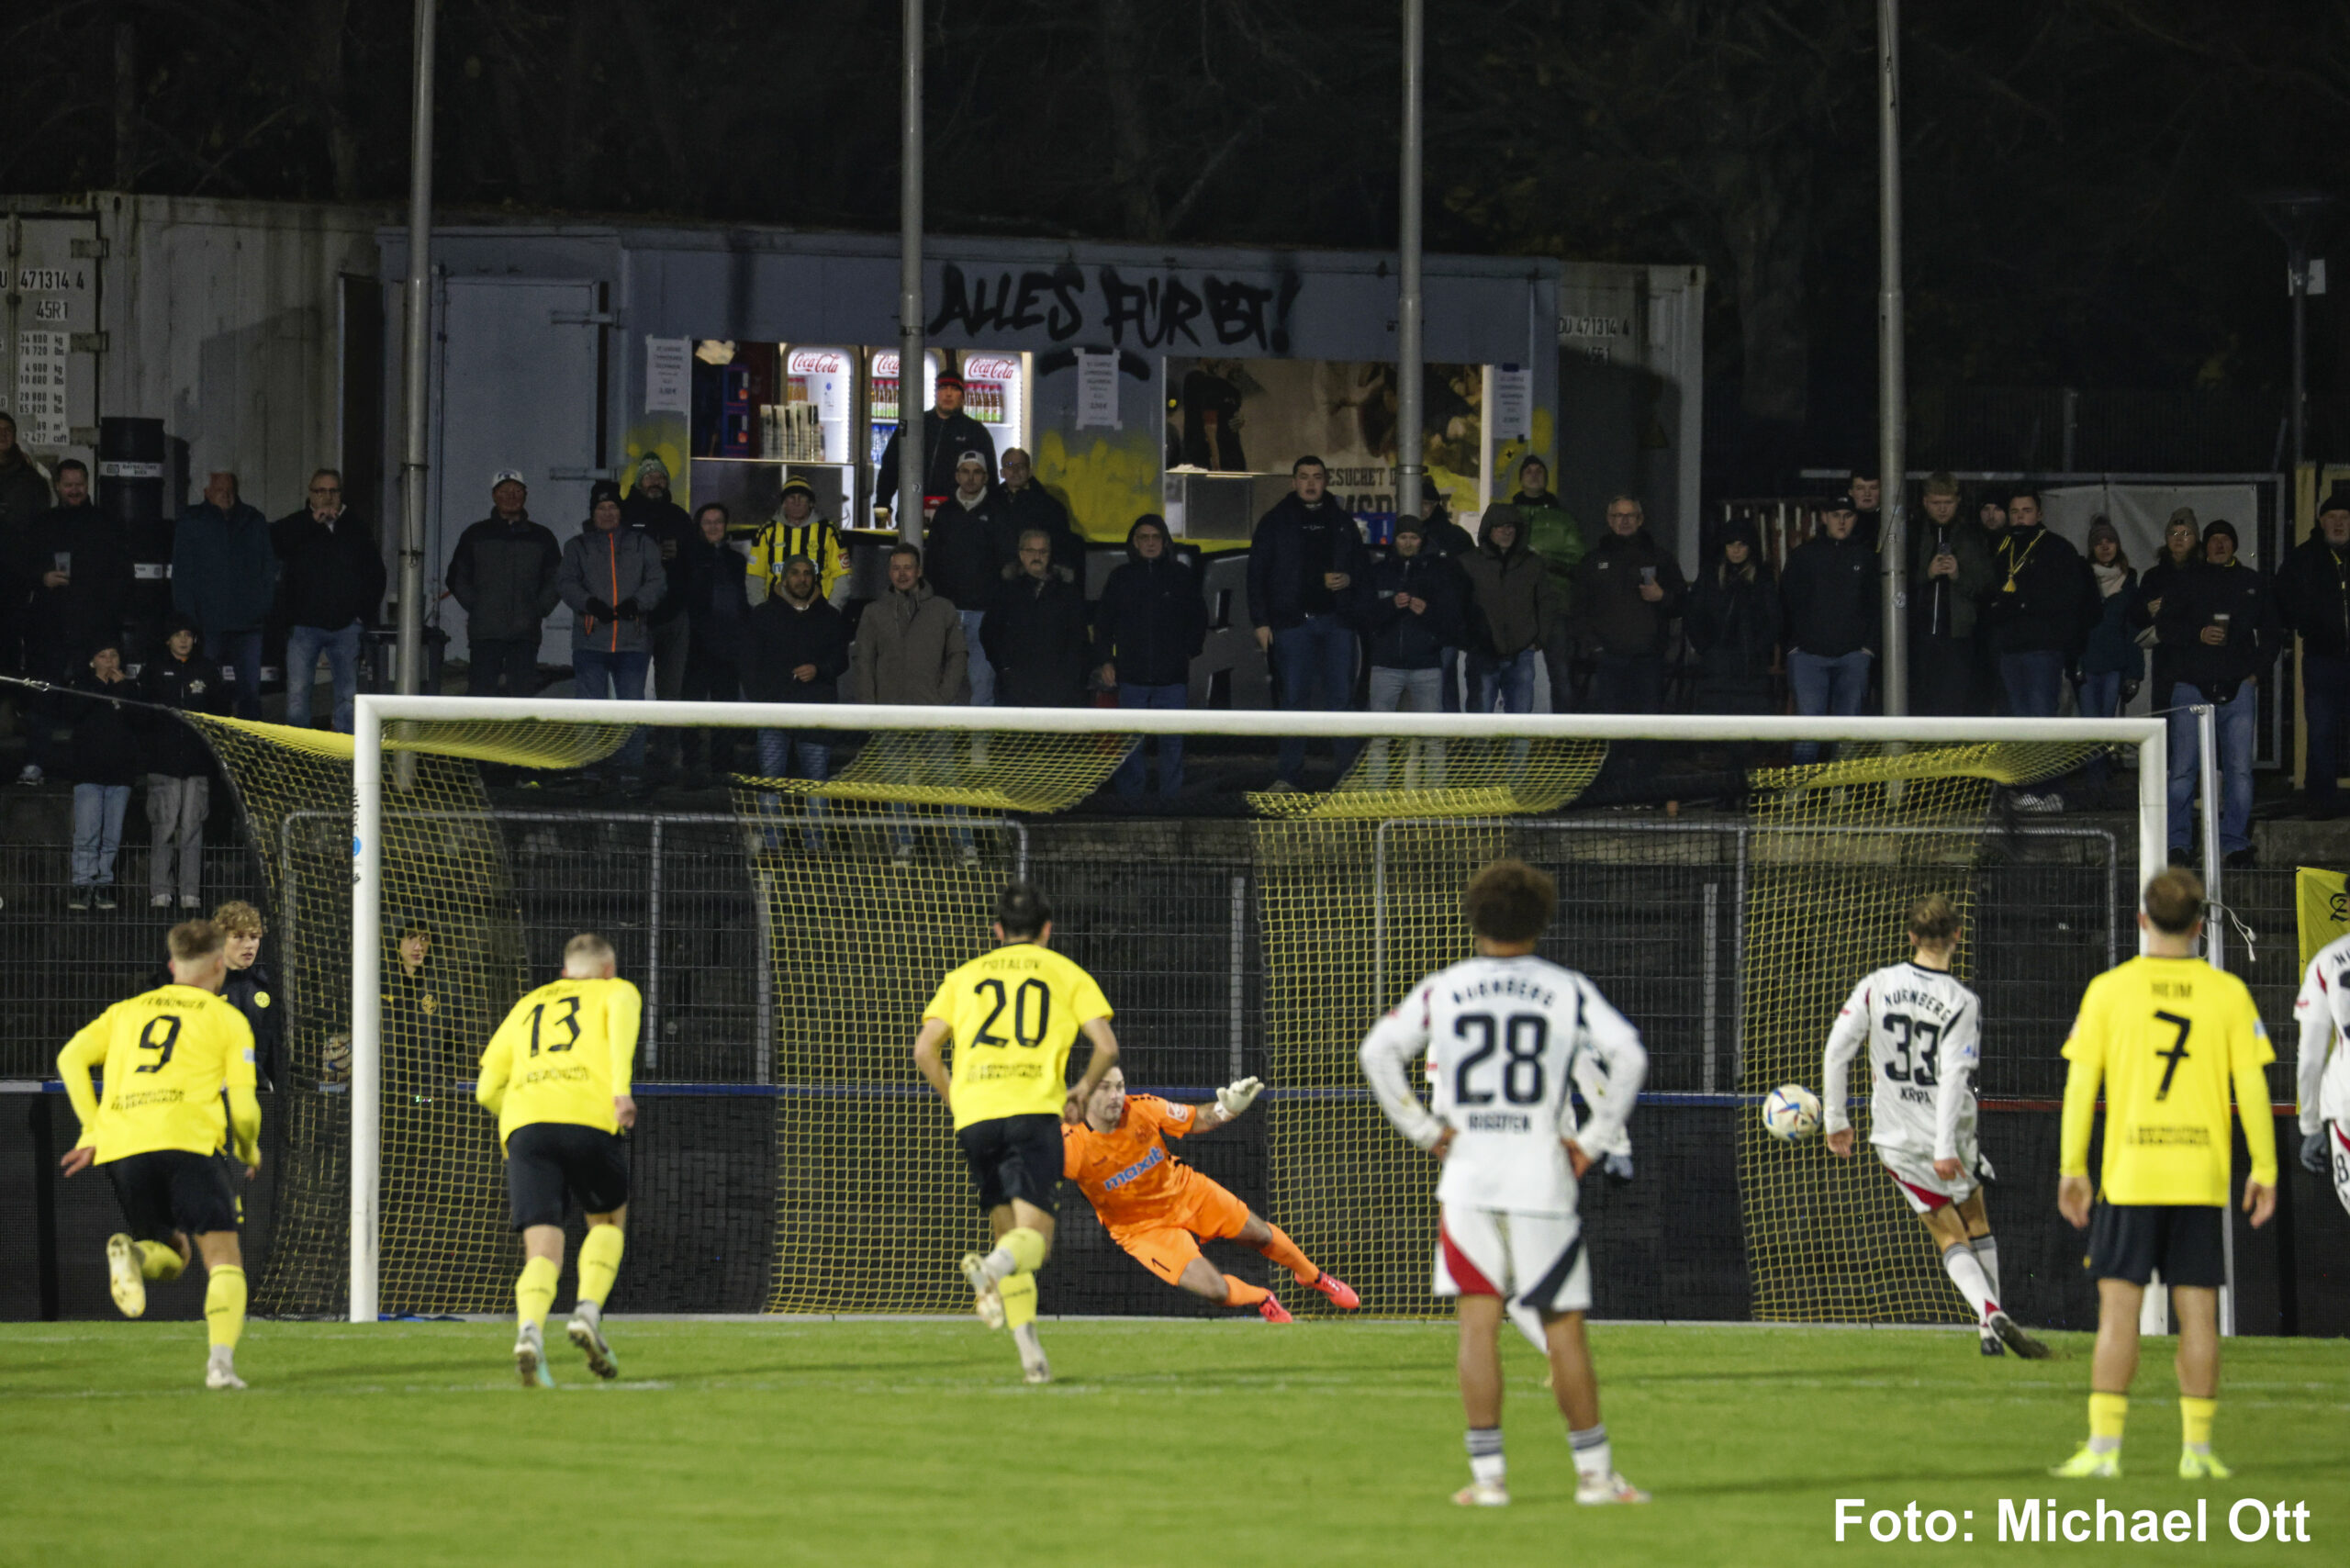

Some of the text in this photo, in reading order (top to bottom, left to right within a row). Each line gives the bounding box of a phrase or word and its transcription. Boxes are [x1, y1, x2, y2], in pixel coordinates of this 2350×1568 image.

[20, 271, 70, 290] 471314
[76, 271, 84, 290] 4
[37, 300, 68, 319] 45R1
[927, 259, 1085, 342] ALLES
[1100, 263, 1203, 349] FÜR
[1577, 316, 1617, 336] 471314
[1325, 466, 1385, 487] ESUCHET
[522, 996, 581, 1058] 13
[970, 978, 1050, 1048] 20
[134, 1014, 182, 1074] 9
[1454, 1013, 1548, 1105] 28
[1883, 1013, 1941, 1086] 33
[2153, 1010, 2192, 1102] 7
[1103, 1146, 1165, 1192] maxit
